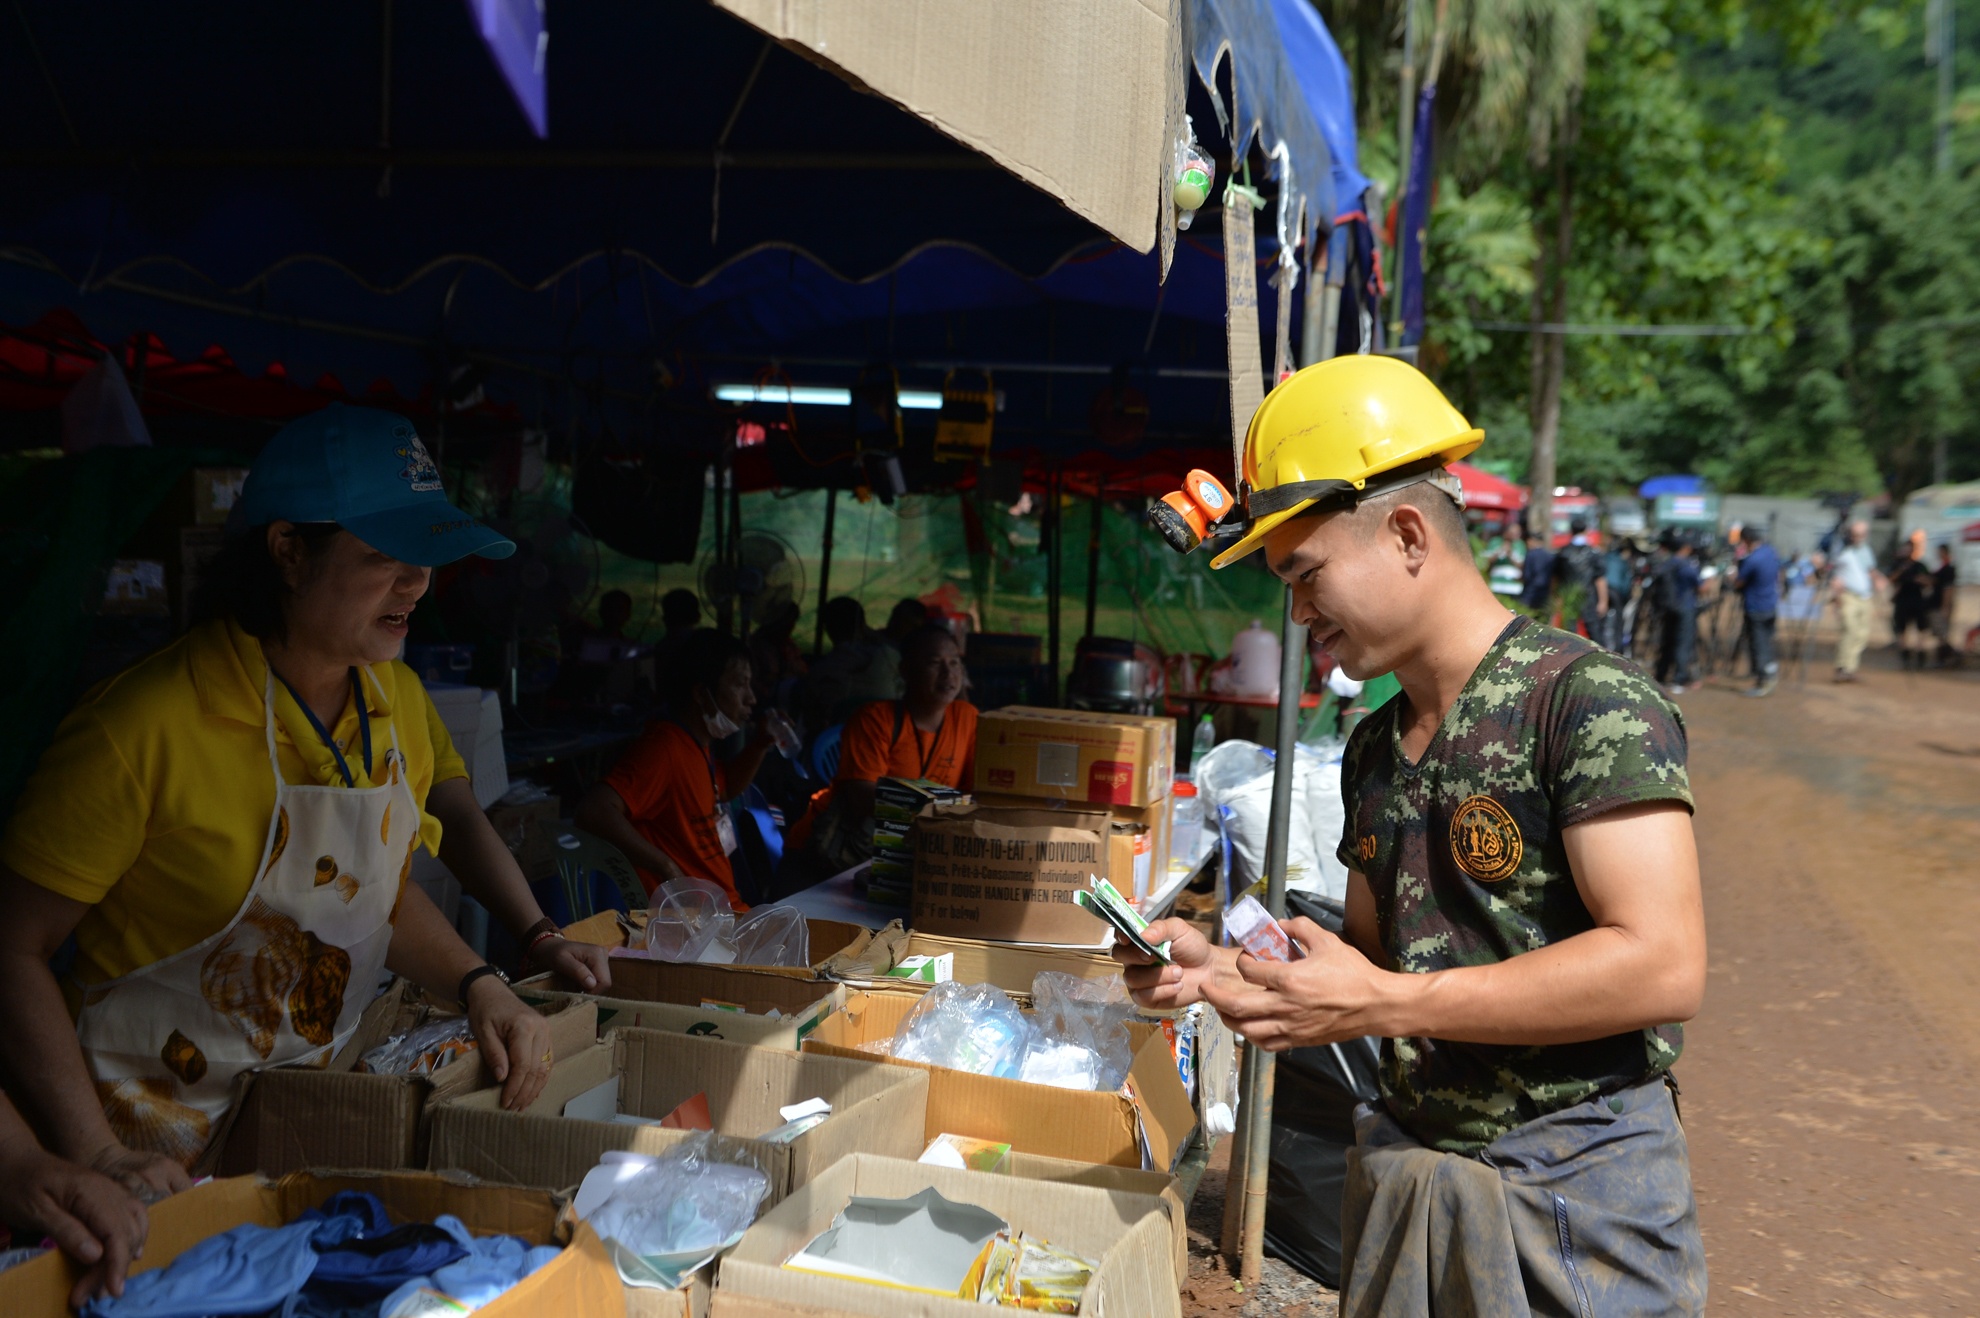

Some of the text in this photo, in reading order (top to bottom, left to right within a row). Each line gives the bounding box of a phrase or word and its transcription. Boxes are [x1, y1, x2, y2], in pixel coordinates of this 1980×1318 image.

[1036, 841, 1098, 864] INDIVIDUAL
[1037, 869, 1085, 886] Individuel)
[931, 882, 949, 897] NOT
[952, 883, 982, 899] ROUGH
[985, 886, 1020, 902] HANDLE
[1022, 888, 1049, 903] WHEN
[1052, 889, 1075, 905] FROZ
